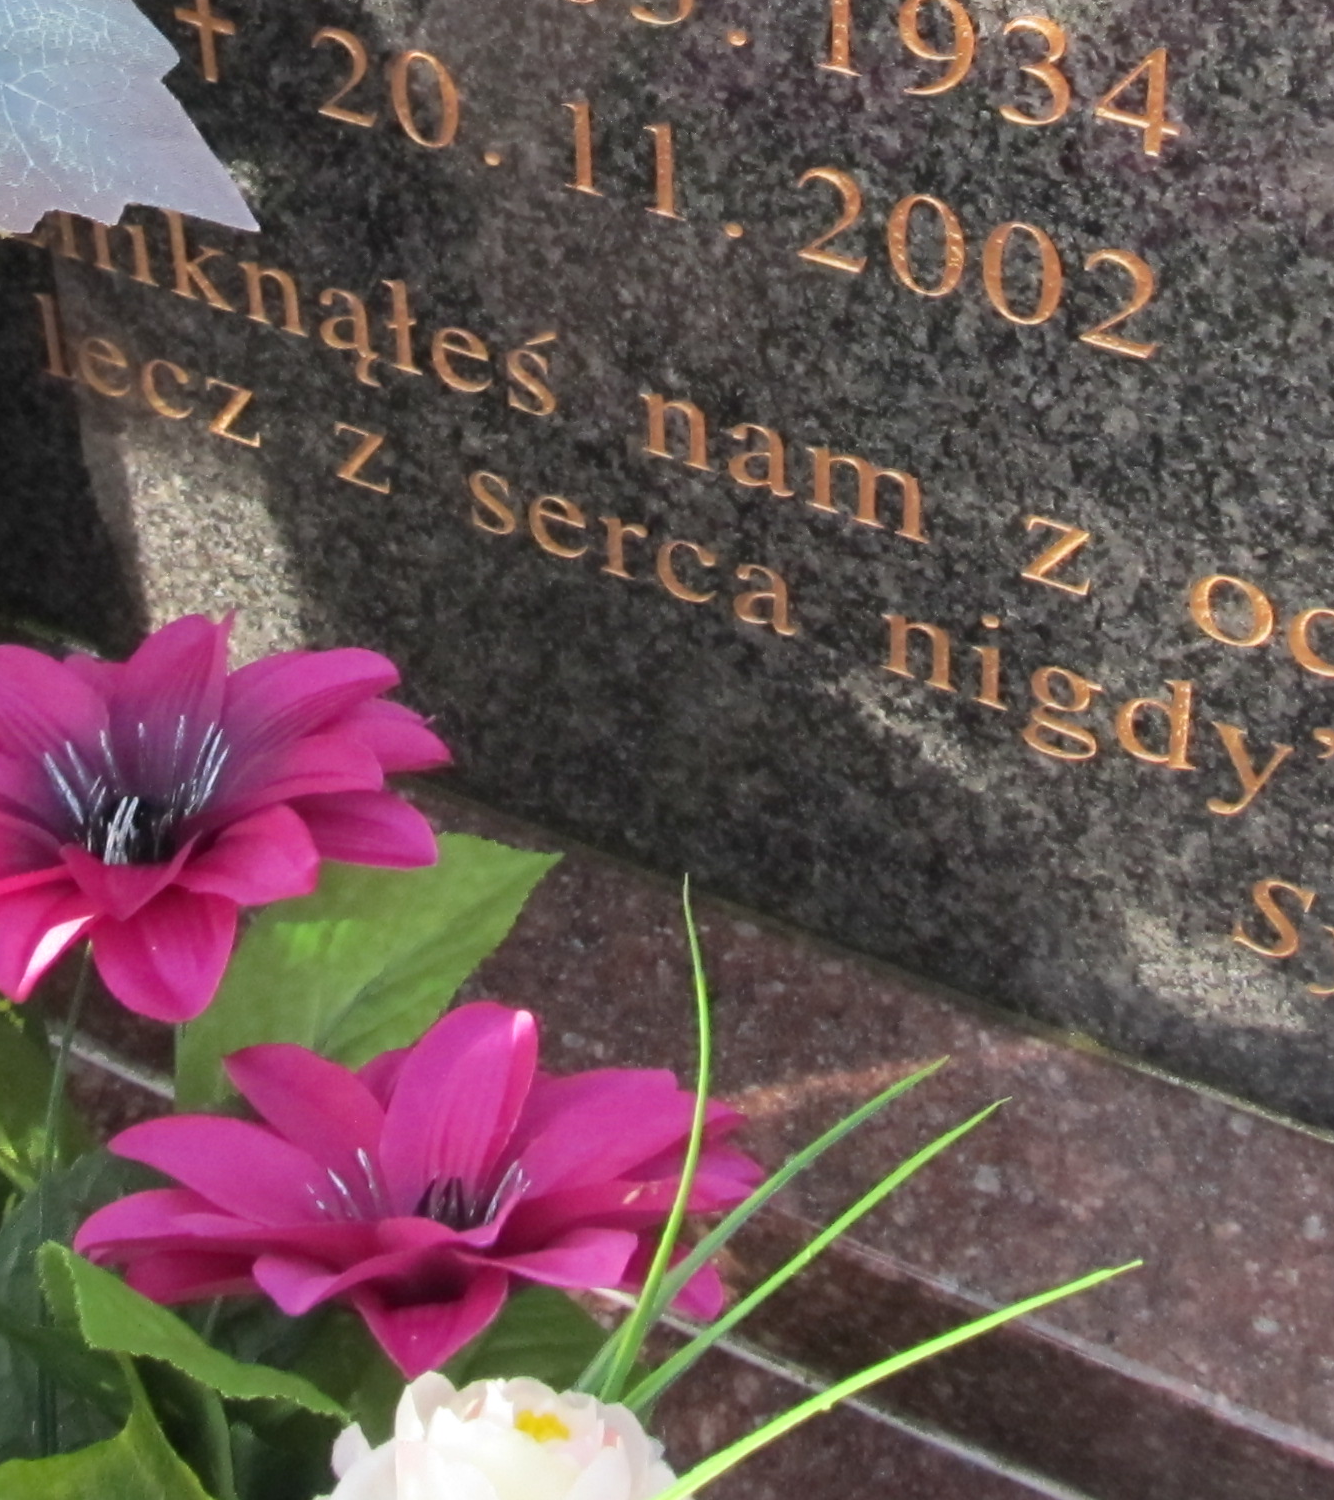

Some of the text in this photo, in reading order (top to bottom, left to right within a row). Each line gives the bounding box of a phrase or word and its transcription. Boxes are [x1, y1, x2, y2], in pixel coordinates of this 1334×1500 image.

[9, 204, 558, 417] niknąłeś
[639, 392, 930, 544] nam
[1020, 513, 1092, 597] z
[796, 165, 1159, 359] 2002
[32, 291, 263, 449] lecz
[332, 420, 392, 496] z
[466, 469, 799, 638] serca
